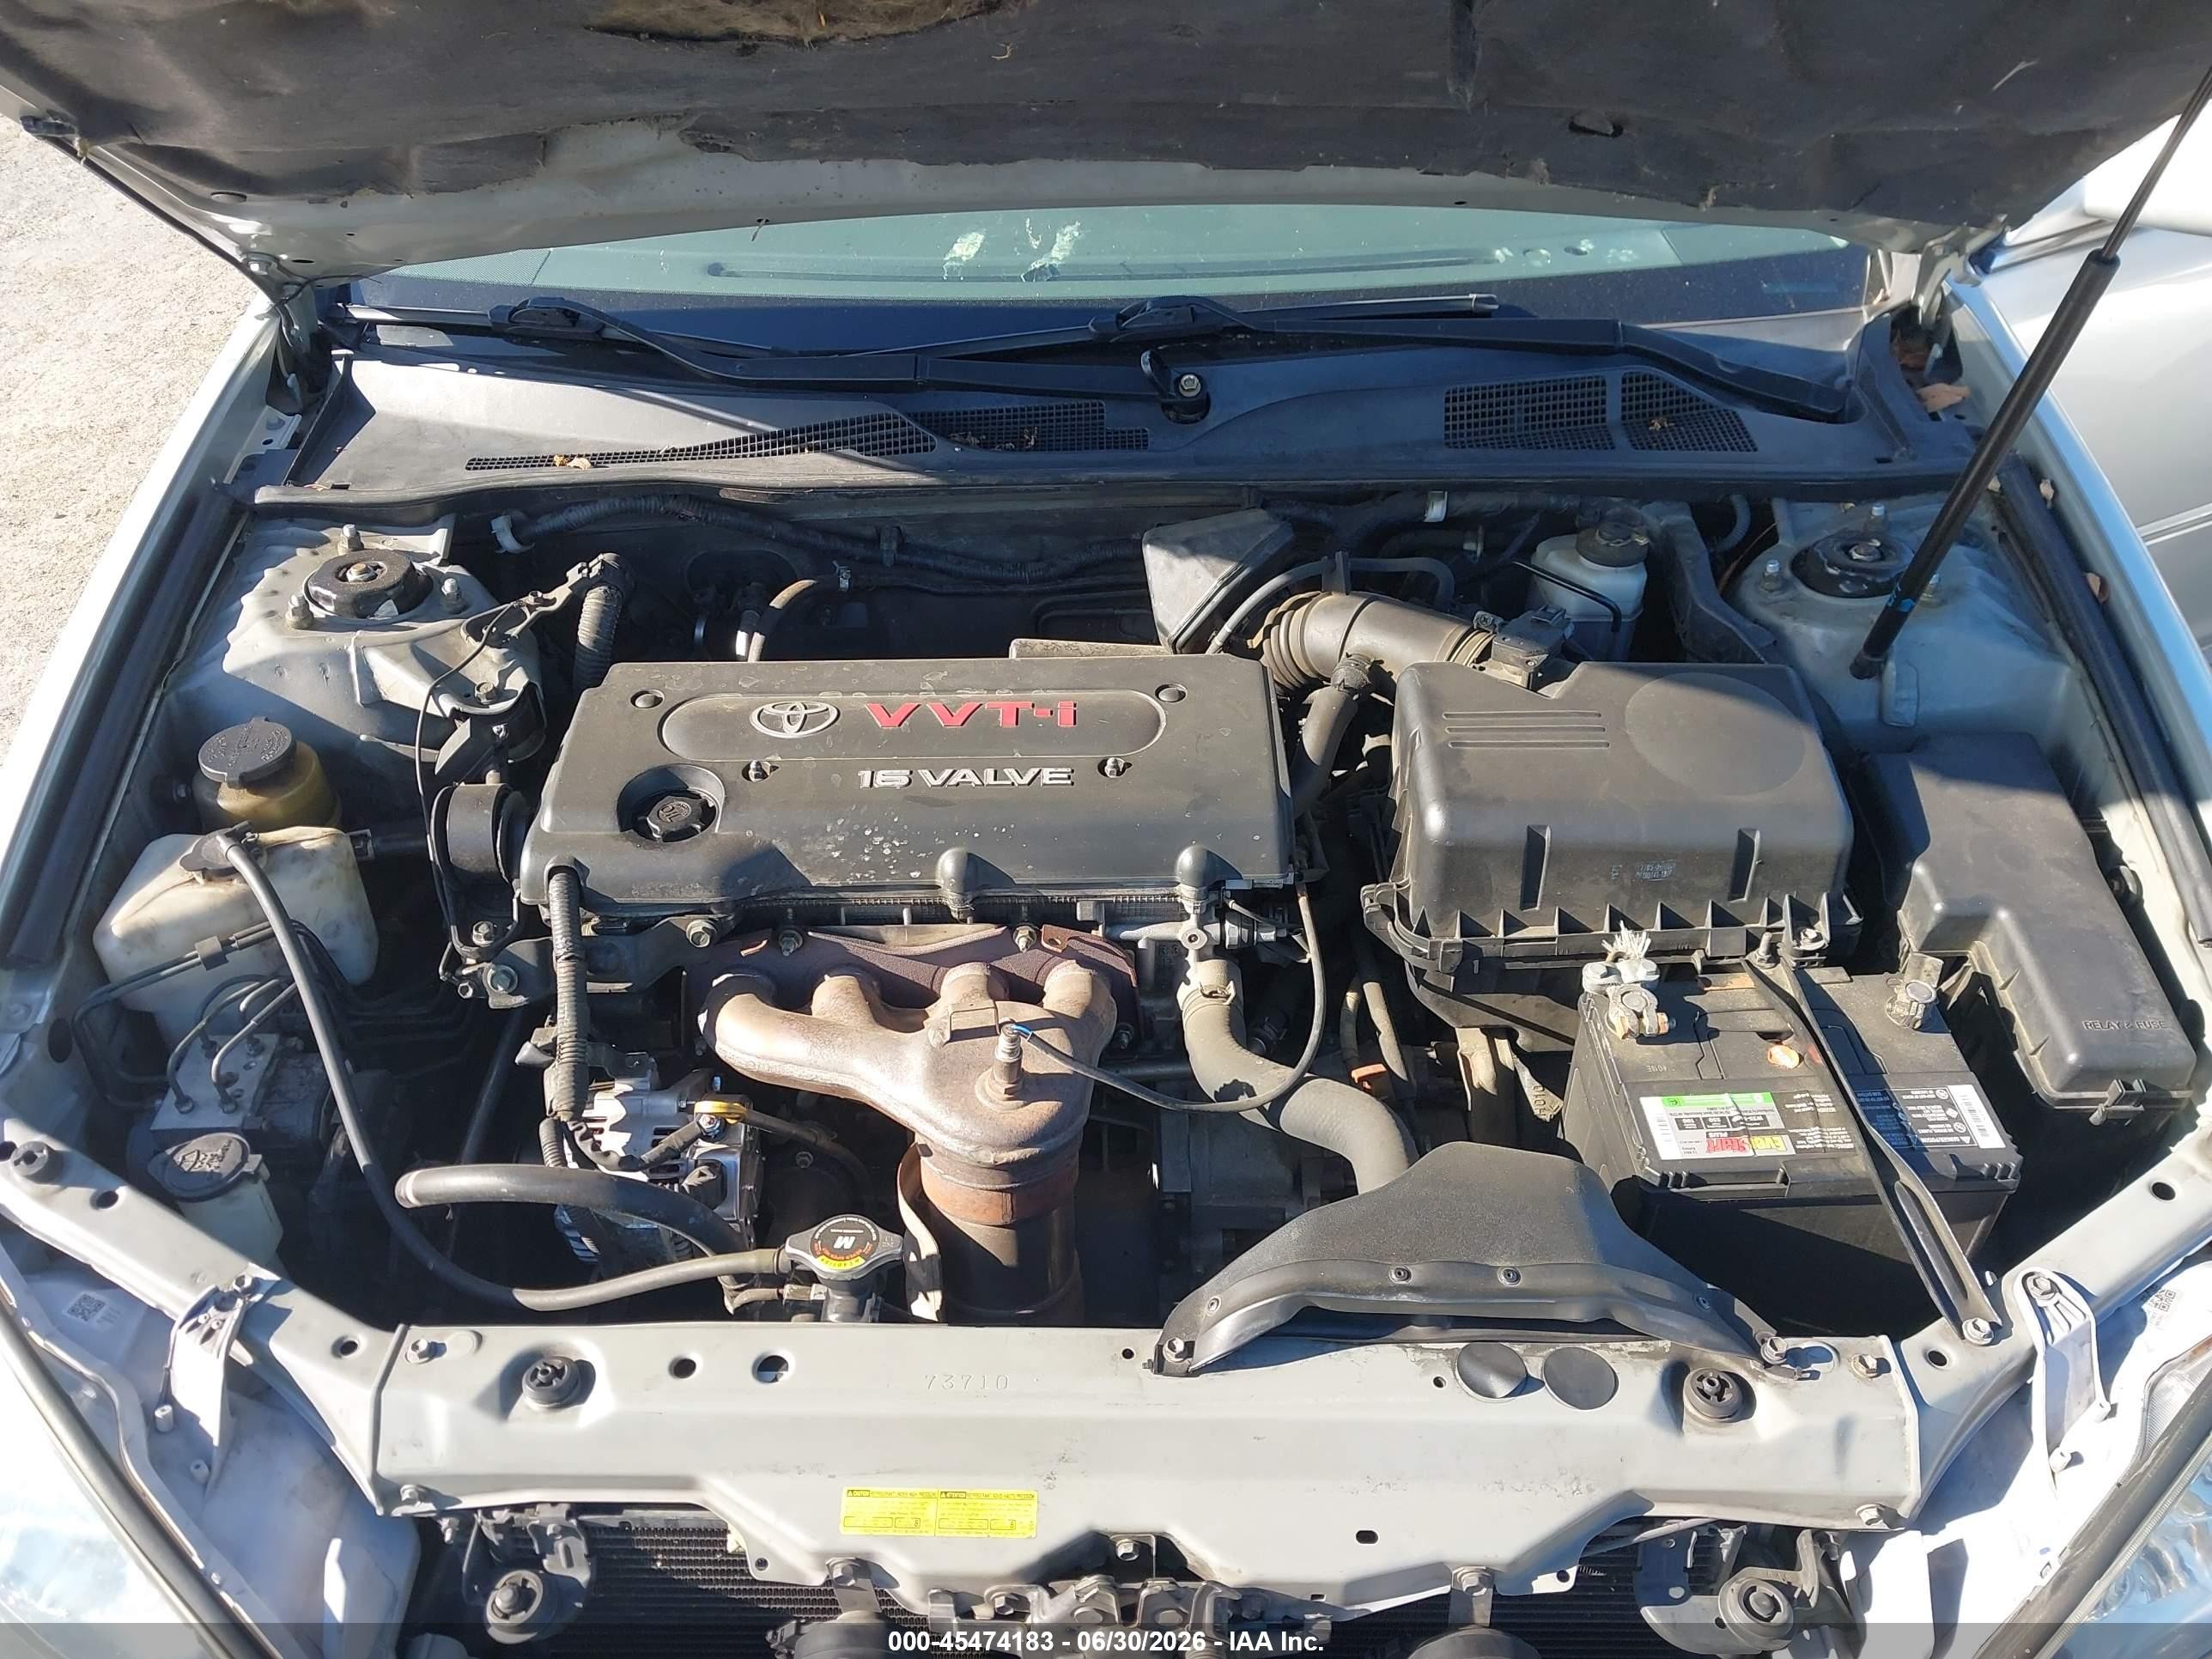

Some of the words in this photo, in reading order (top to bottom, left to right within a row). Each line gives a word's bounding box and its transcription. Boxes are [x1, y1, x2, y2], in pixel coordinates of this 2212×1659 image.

[866, 701, 1077, 727] VVT-i
[859, 769, 913, 788] 16
[917, 768, 1074, 787] VALVE
[2081, 1020, 2121, 1030] RELAY
[2135, 1020, 2168, 1030] FUSE
[925, 1374, 1010, 1391] 73710
